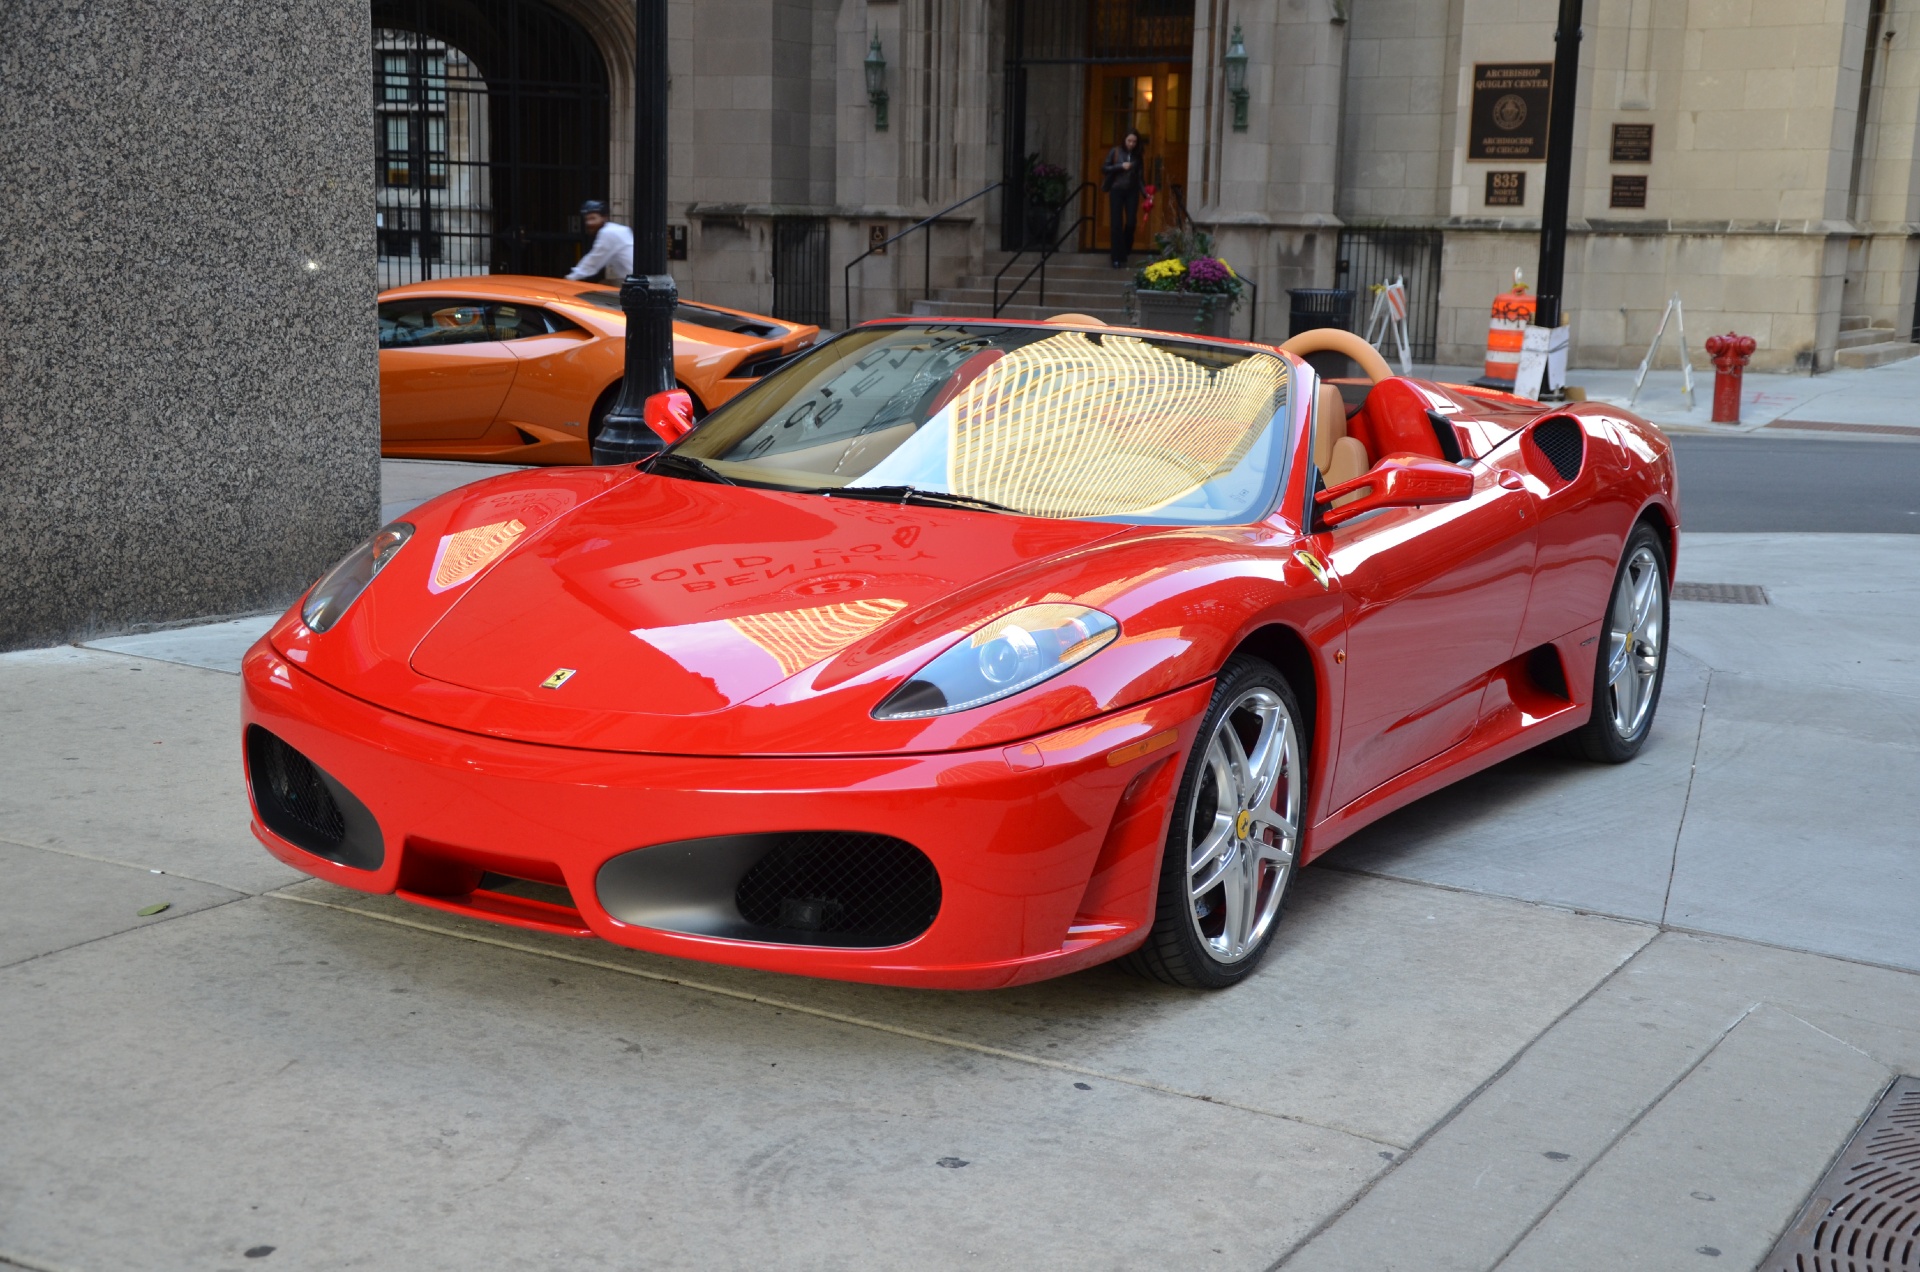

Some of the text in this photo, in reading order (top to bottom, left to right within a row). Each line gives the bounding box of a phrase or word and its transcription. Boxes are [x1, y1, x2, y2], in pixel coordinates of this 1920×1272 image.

[1485, 69, 1540, 78] ARCHBISHOP
[1476, 79, 1548, 90] QUIGLEY CENTER
[1483, 137, 1534, 145] ARCHDIOCESE
[1497, 146, 1529, 154] CHICAGO
[1493, 174, 1518, 188] 835
